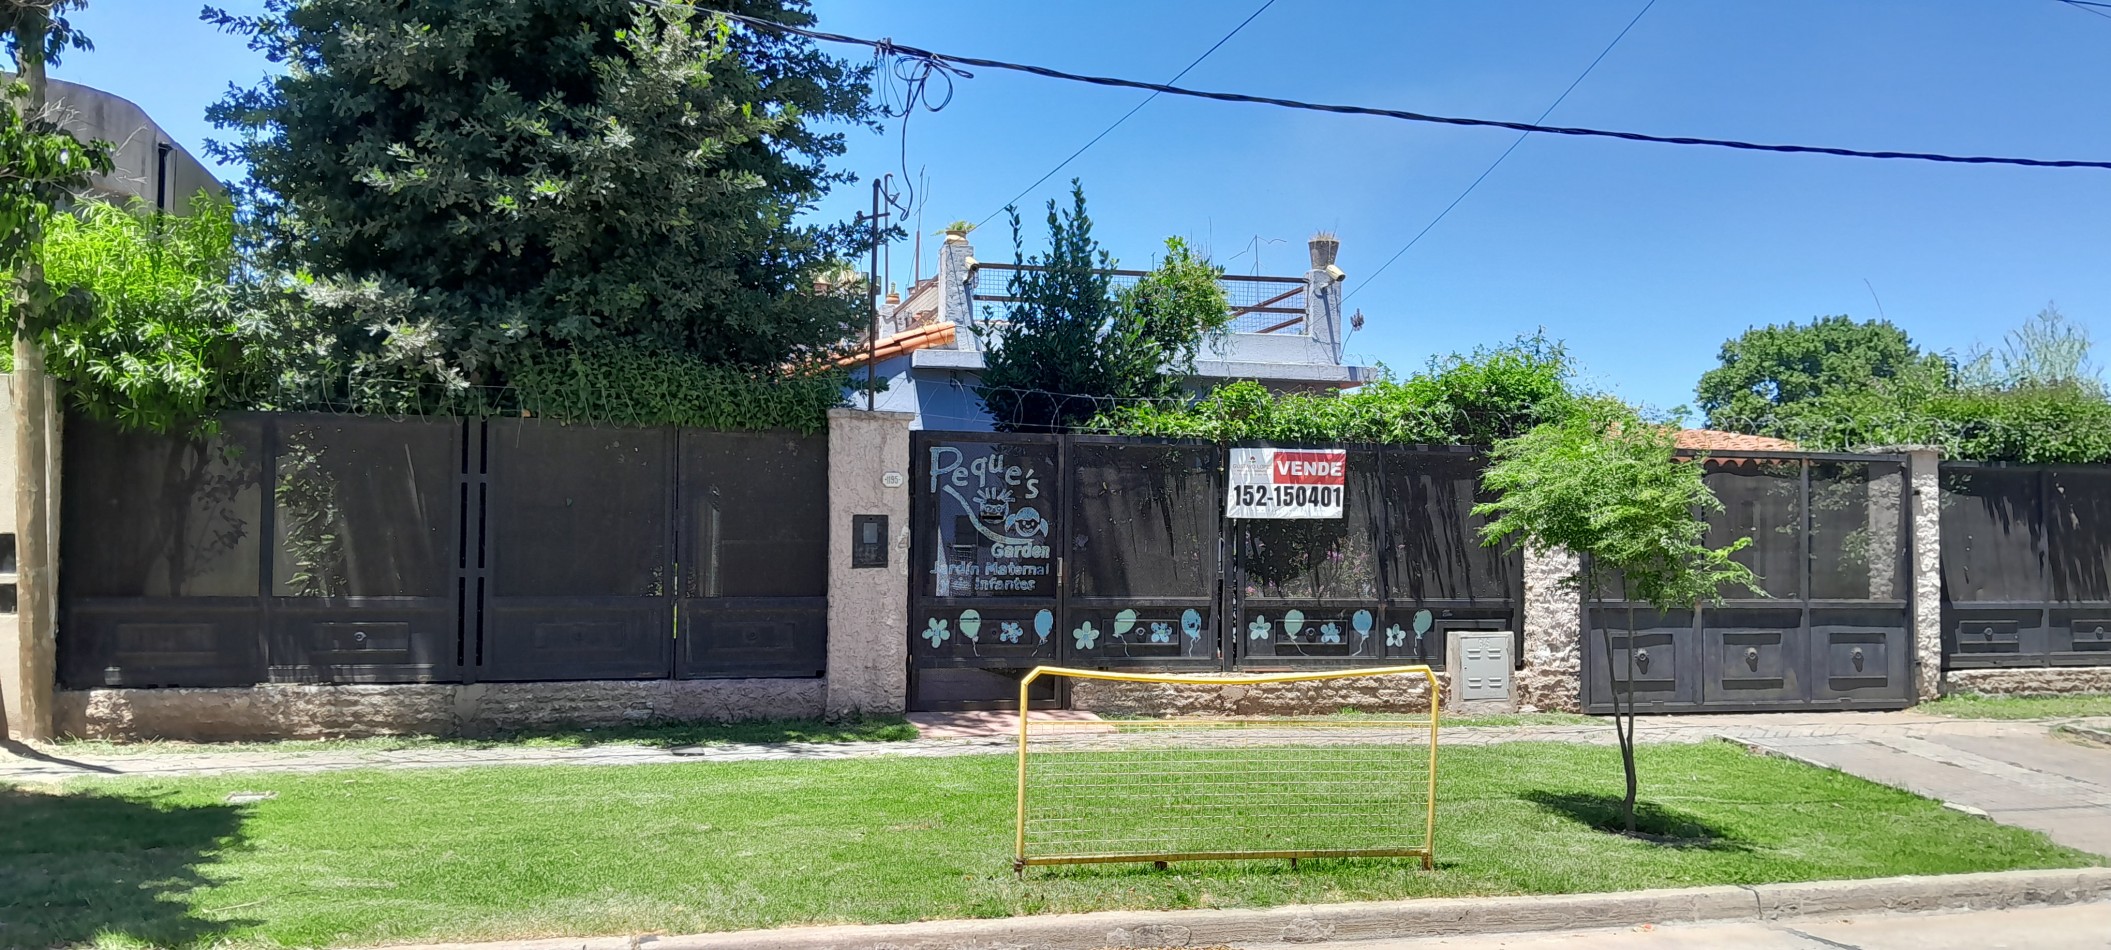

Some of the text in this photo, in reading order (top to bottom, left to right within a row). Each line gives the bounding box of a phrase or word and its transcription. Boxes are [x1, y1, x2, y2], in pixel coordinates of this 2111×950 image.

[930, 446, 1040, 500] Peque's
[1277, 461, 1343, 477] VENDE
[1233, 484, 1342, 508] 152-150401
[990, 542, 1051, 559] Garden
[984, 561, 1050, 576] Maternal
[974, 577, 1036, 591] Infantes
